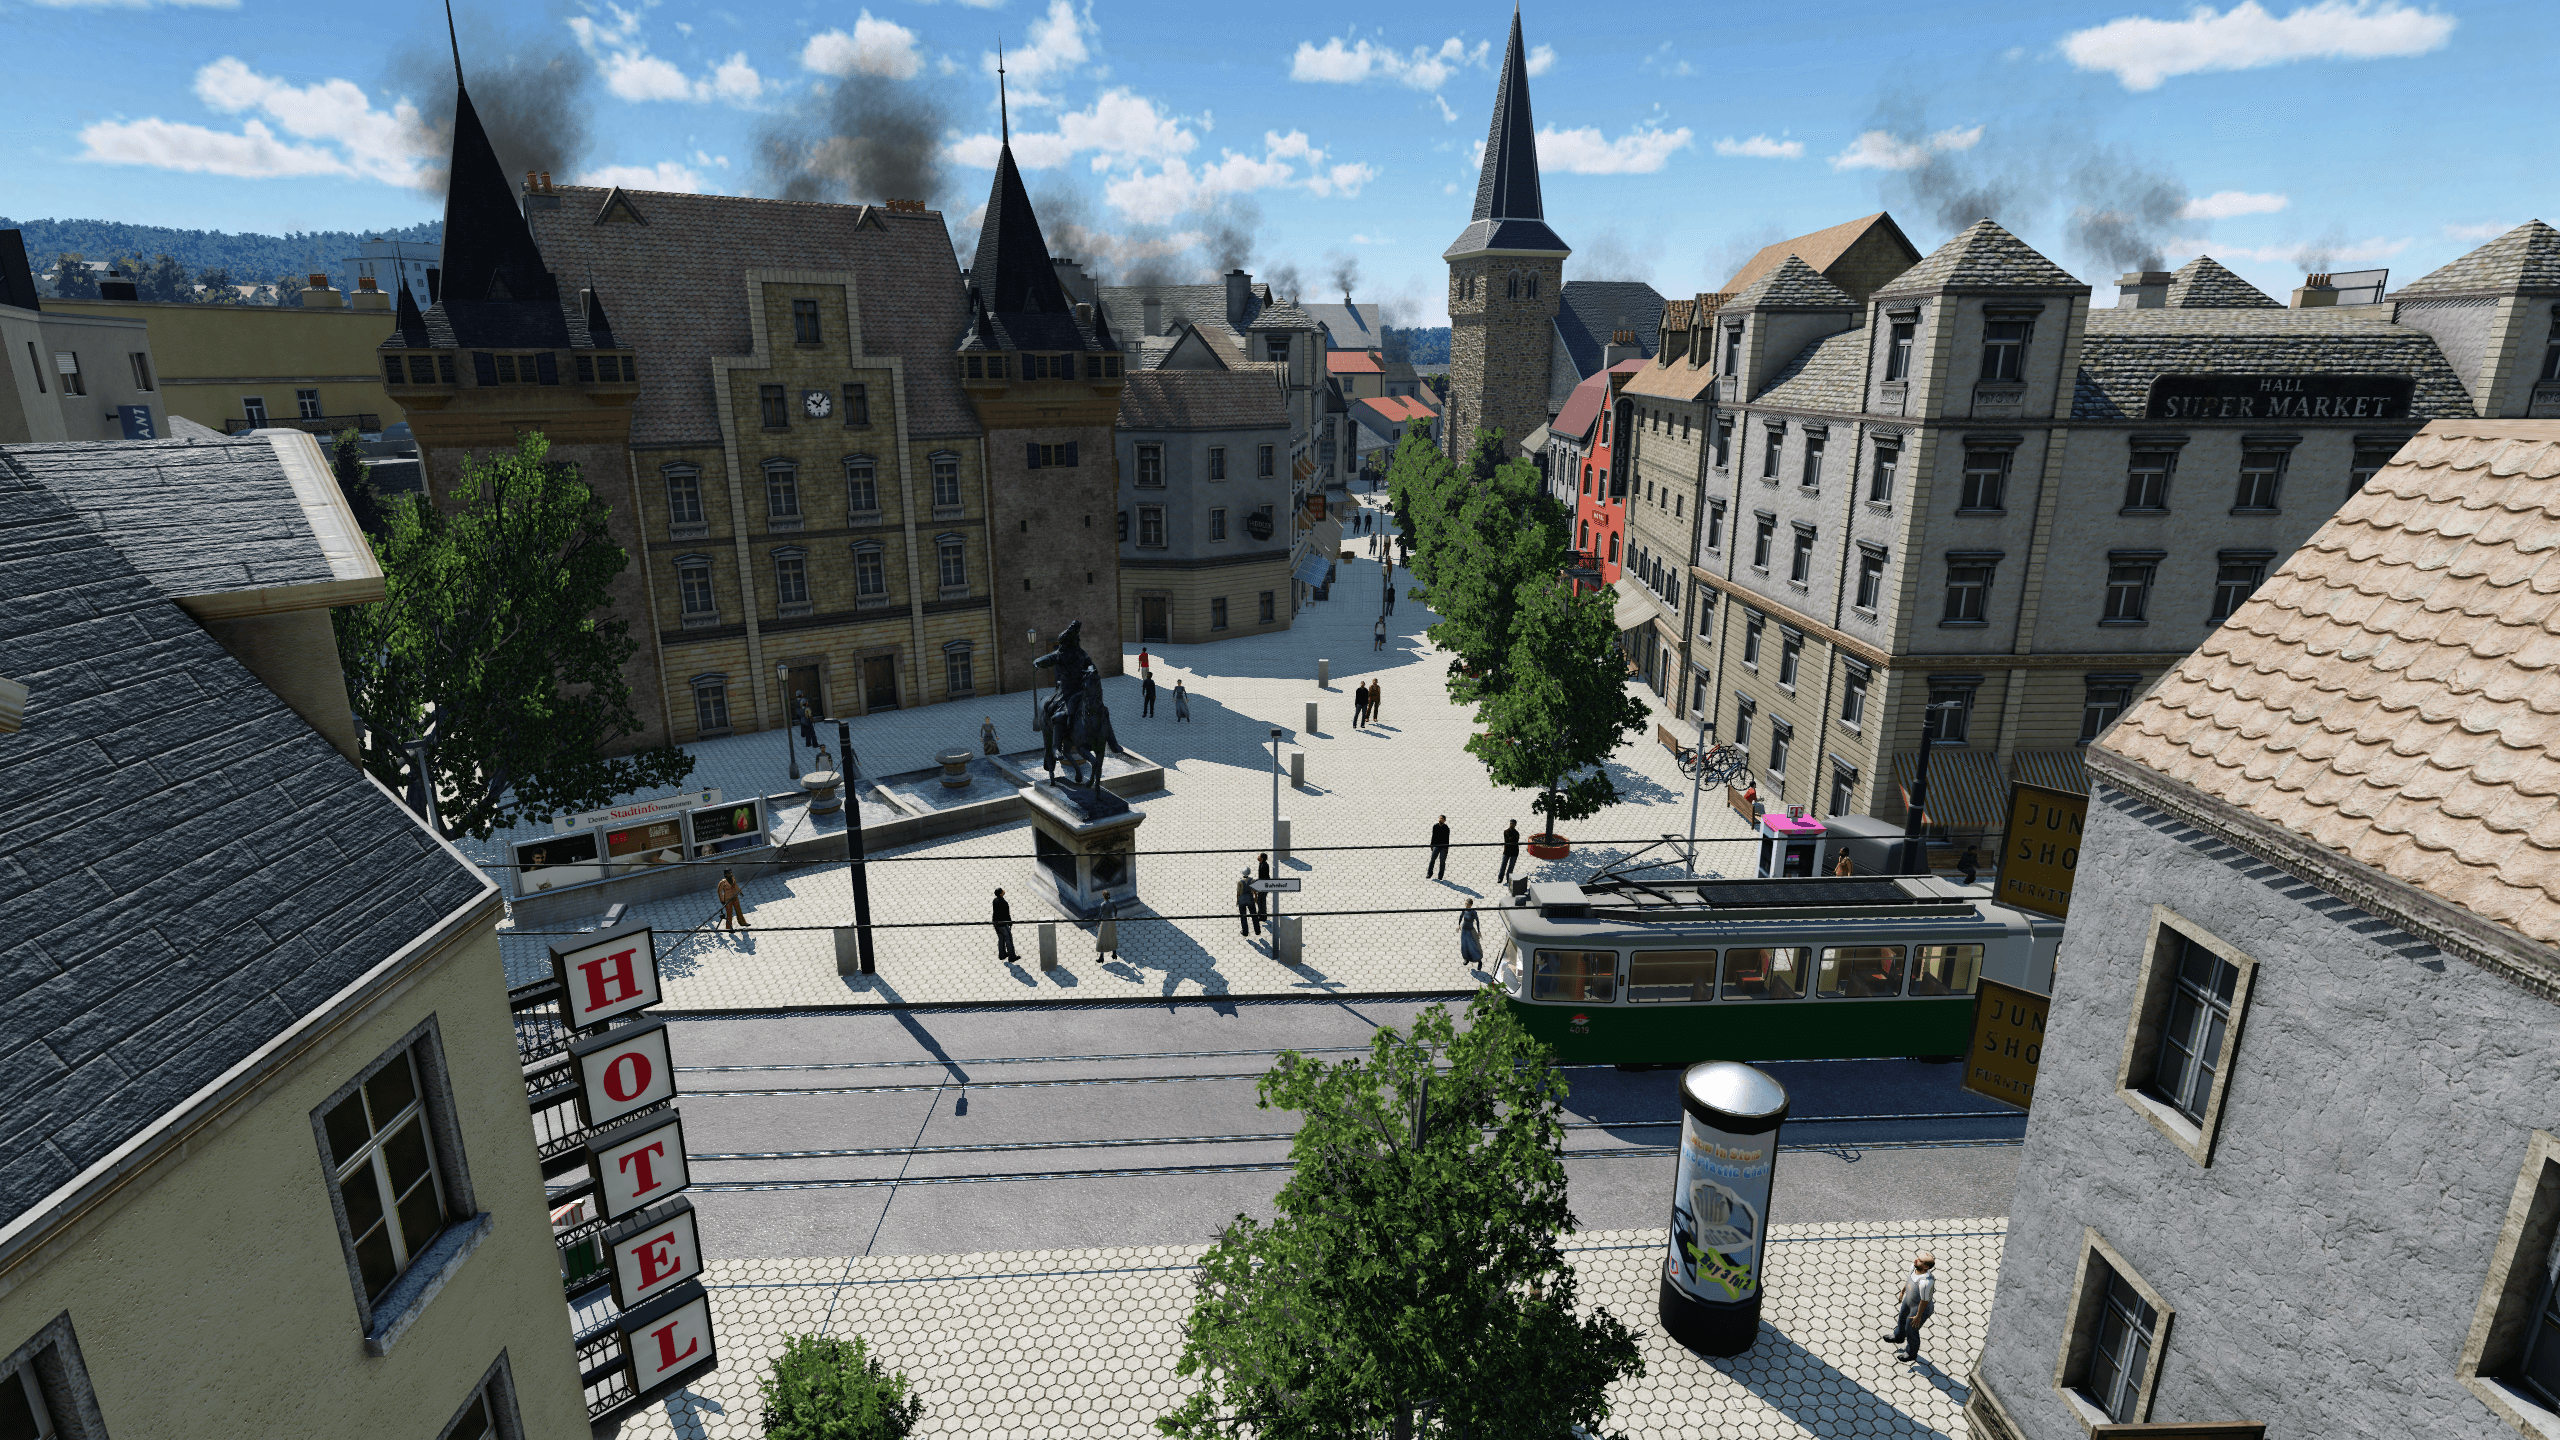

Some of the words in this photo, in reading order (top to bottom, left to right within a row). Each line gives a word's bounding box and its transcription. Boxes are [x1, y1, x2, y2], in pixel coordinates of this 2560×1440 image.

[2259, 378, 2304, 392] HALL
[2164, 396, 2254, 418] SUPER
[2266, 396, 2391, 418] MARKET
[132, 407, 151, 438] ANT
[1615, 401, 1629, 494] GUESTHOUSE
[1248, 519, 1272, 529] SADDLER
[588, 815, 609, 824] Deine
[2024, 803, 2085, 836] JUN
[2017, 838, 2079, 871] SHO
[2008, 878, 2071, 905] FURNIT
[1569, 1026, 1590, 1034] 4019
[1989, 999, 2048, 1034] JUN
[1984, 1030, 2041, 1065] SHO
[1974, 1067, 2035, 1097] FURNIT
[578, 949, 698, 1373] HOTEL
[1697, 1154, 1740, 1178] Plastic
[1699, 1252, 1722, 1276] Buy
[1720, 1269, 1732, 1280] 3
[1728, 1274, 1744, 1289] for
[1743, 1279, 1752, 1290] 2
